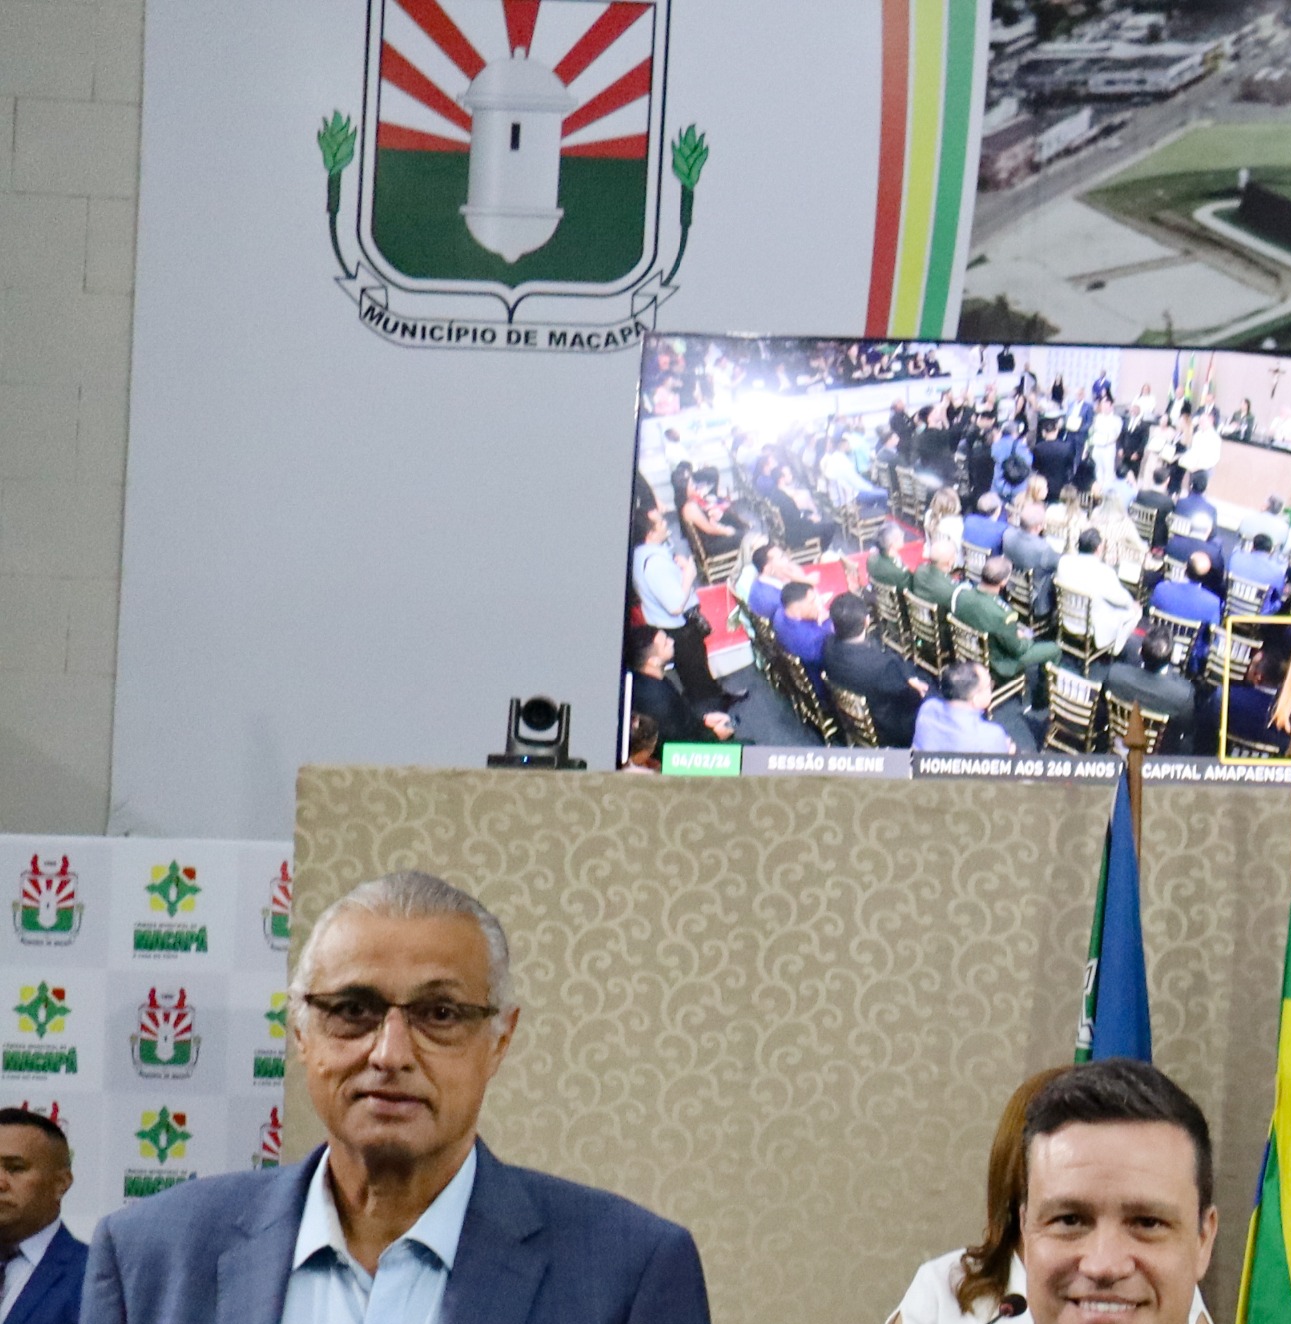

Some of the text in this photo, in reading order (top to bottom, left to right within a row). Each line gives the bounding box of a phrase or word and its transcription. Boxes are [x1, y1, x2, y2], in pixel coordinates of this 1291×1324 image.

[363, 305, 496, 344] MUNICÍPIO
[505, 329, 538, 346] DE
[768, 751, 885, 772] SESSÃO SOLENE
[919, 758, 1011, 776] HOMENAGEM
[1014, 760, 1044, 776] AOS
[1046, 760, 1072, 777] 268
[1074, 761, 1115, 778] ANOS
[1141, 763, 1201, 780] CAPITAL
